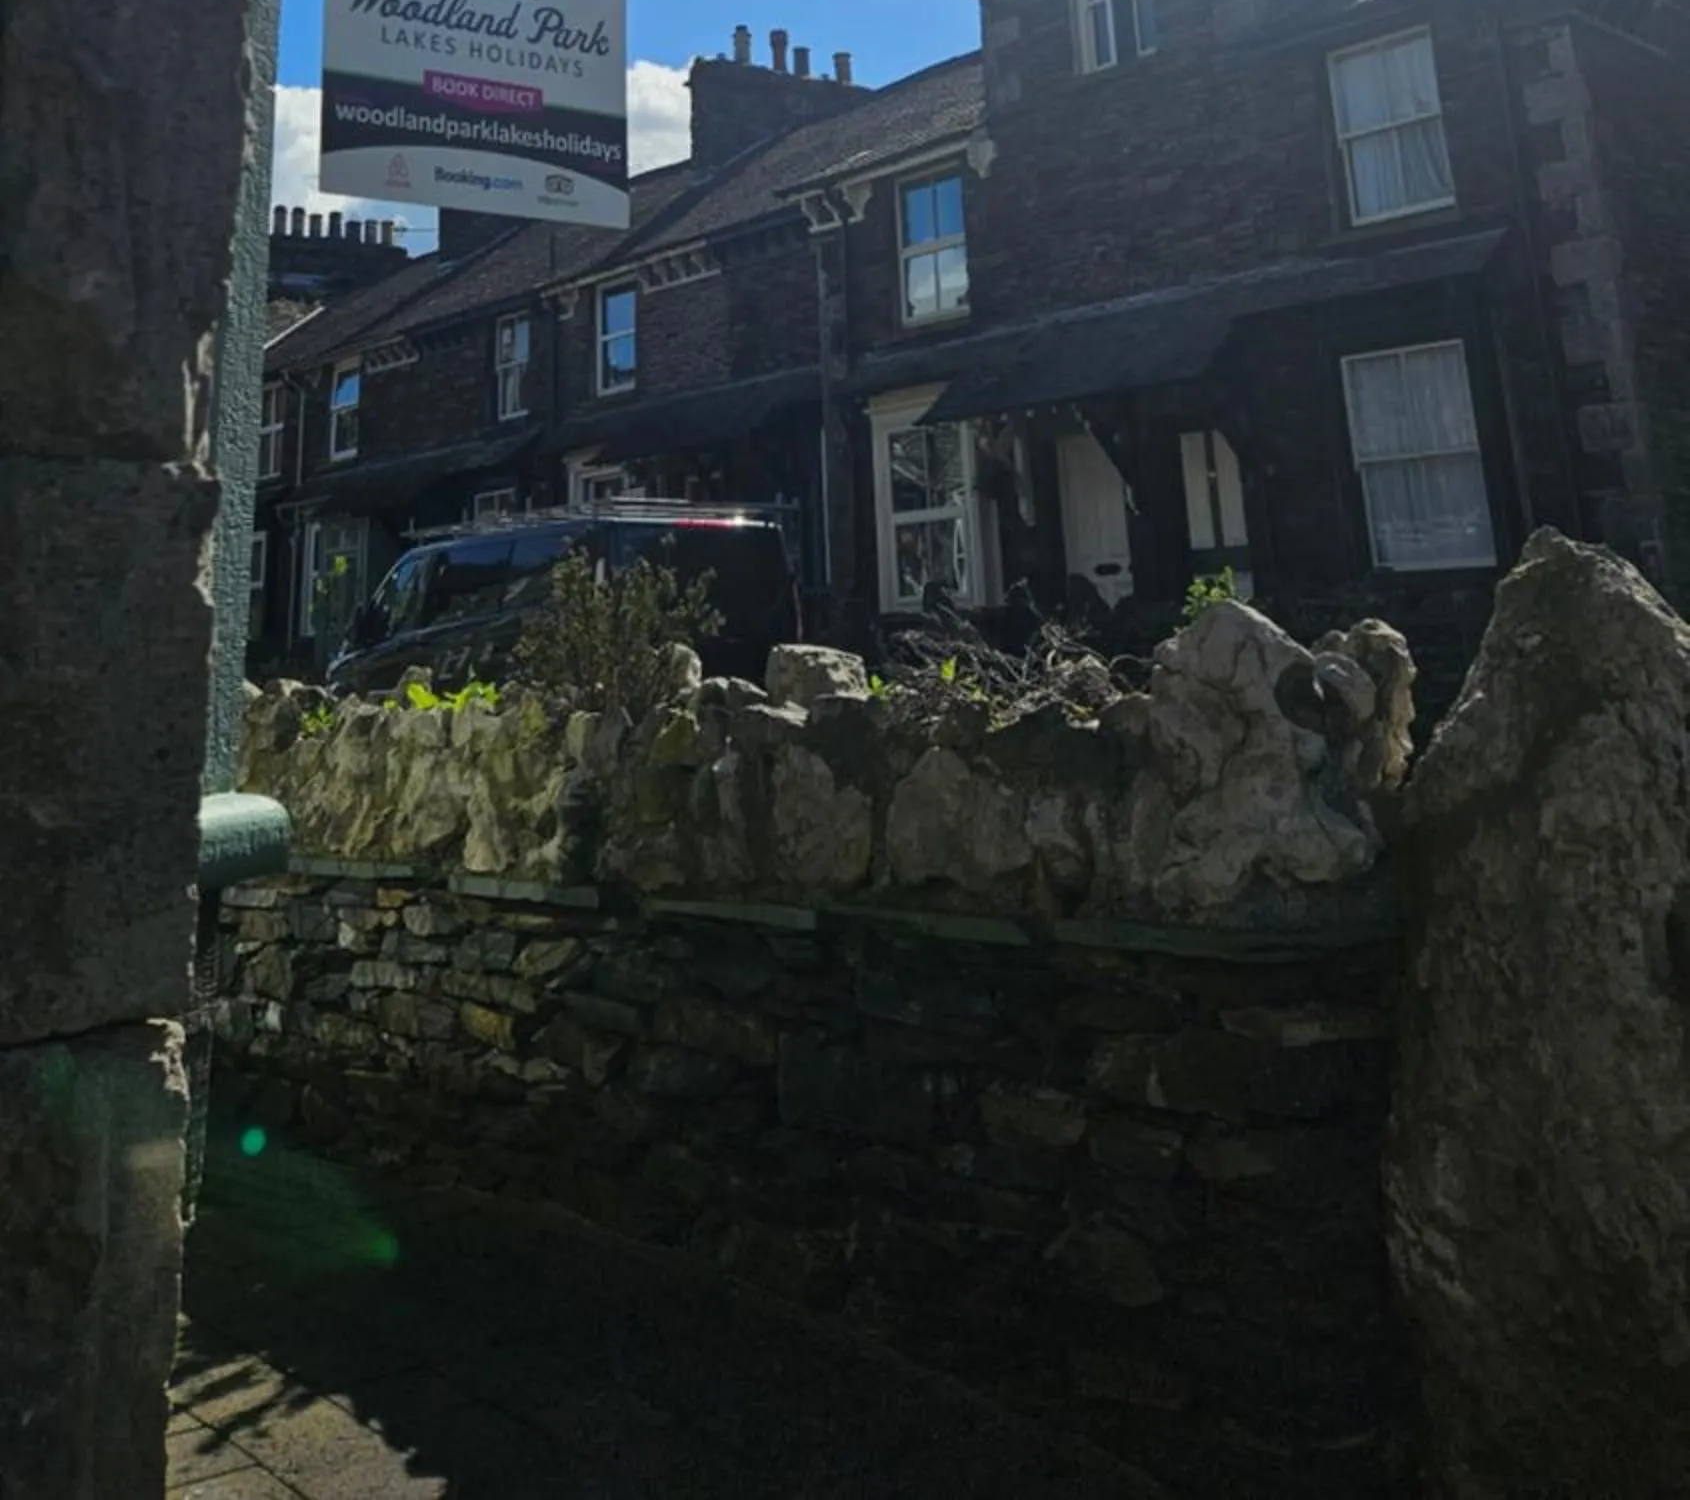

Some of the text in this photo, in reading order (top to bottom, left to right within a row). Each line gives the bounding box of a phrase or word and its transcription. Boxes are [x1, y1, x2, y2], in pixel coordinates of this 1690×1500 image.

[380, 25, 584, 78] LAKES HOLIDAYS
[526, 6, 610, 56] Park
[432, 76, 536, 108] BOOK DIRECT
[335, 102, 622, 161] woodlandparklakesholidays
